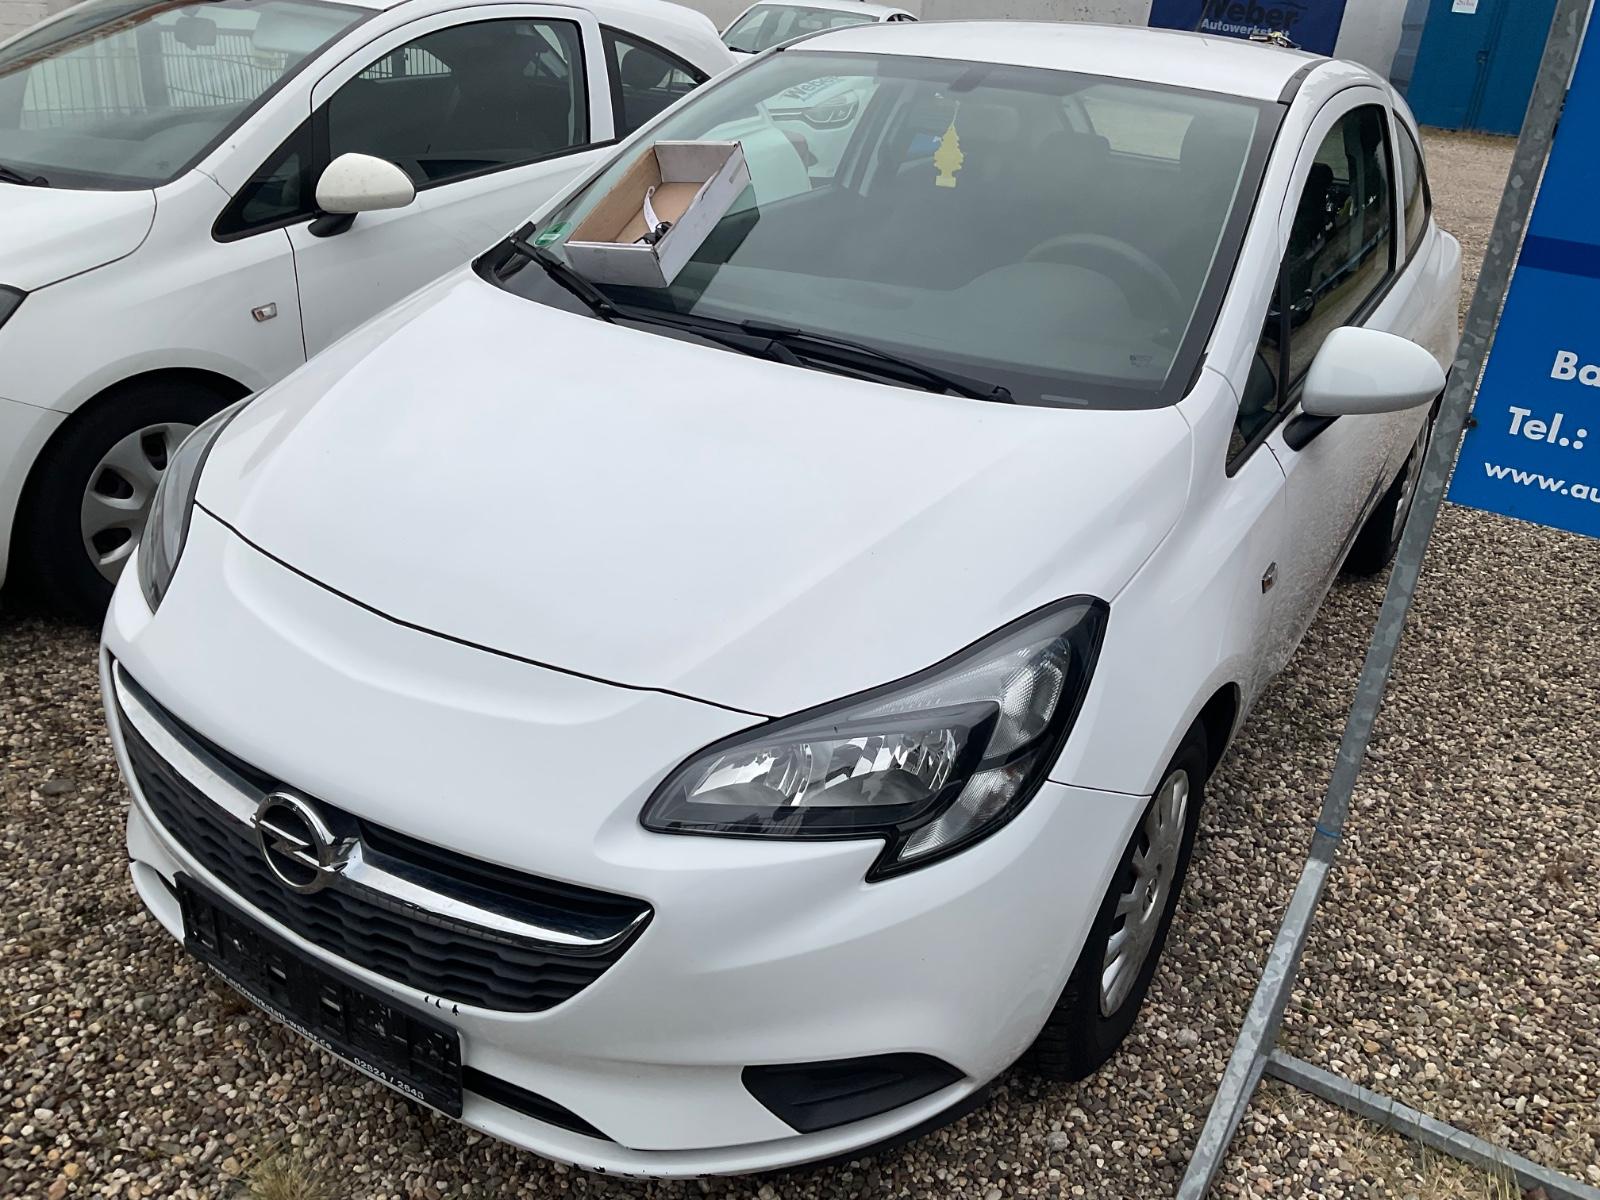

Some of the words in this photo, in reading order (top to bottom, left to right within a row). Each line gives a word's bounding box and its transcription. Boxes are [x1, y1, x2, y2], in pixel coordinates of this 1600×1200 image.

[1551, 350, 1600, 388] Ba
[1509, 406, 1588, 450] Tel.:
[1484, 462, 1600, 503] www.au
